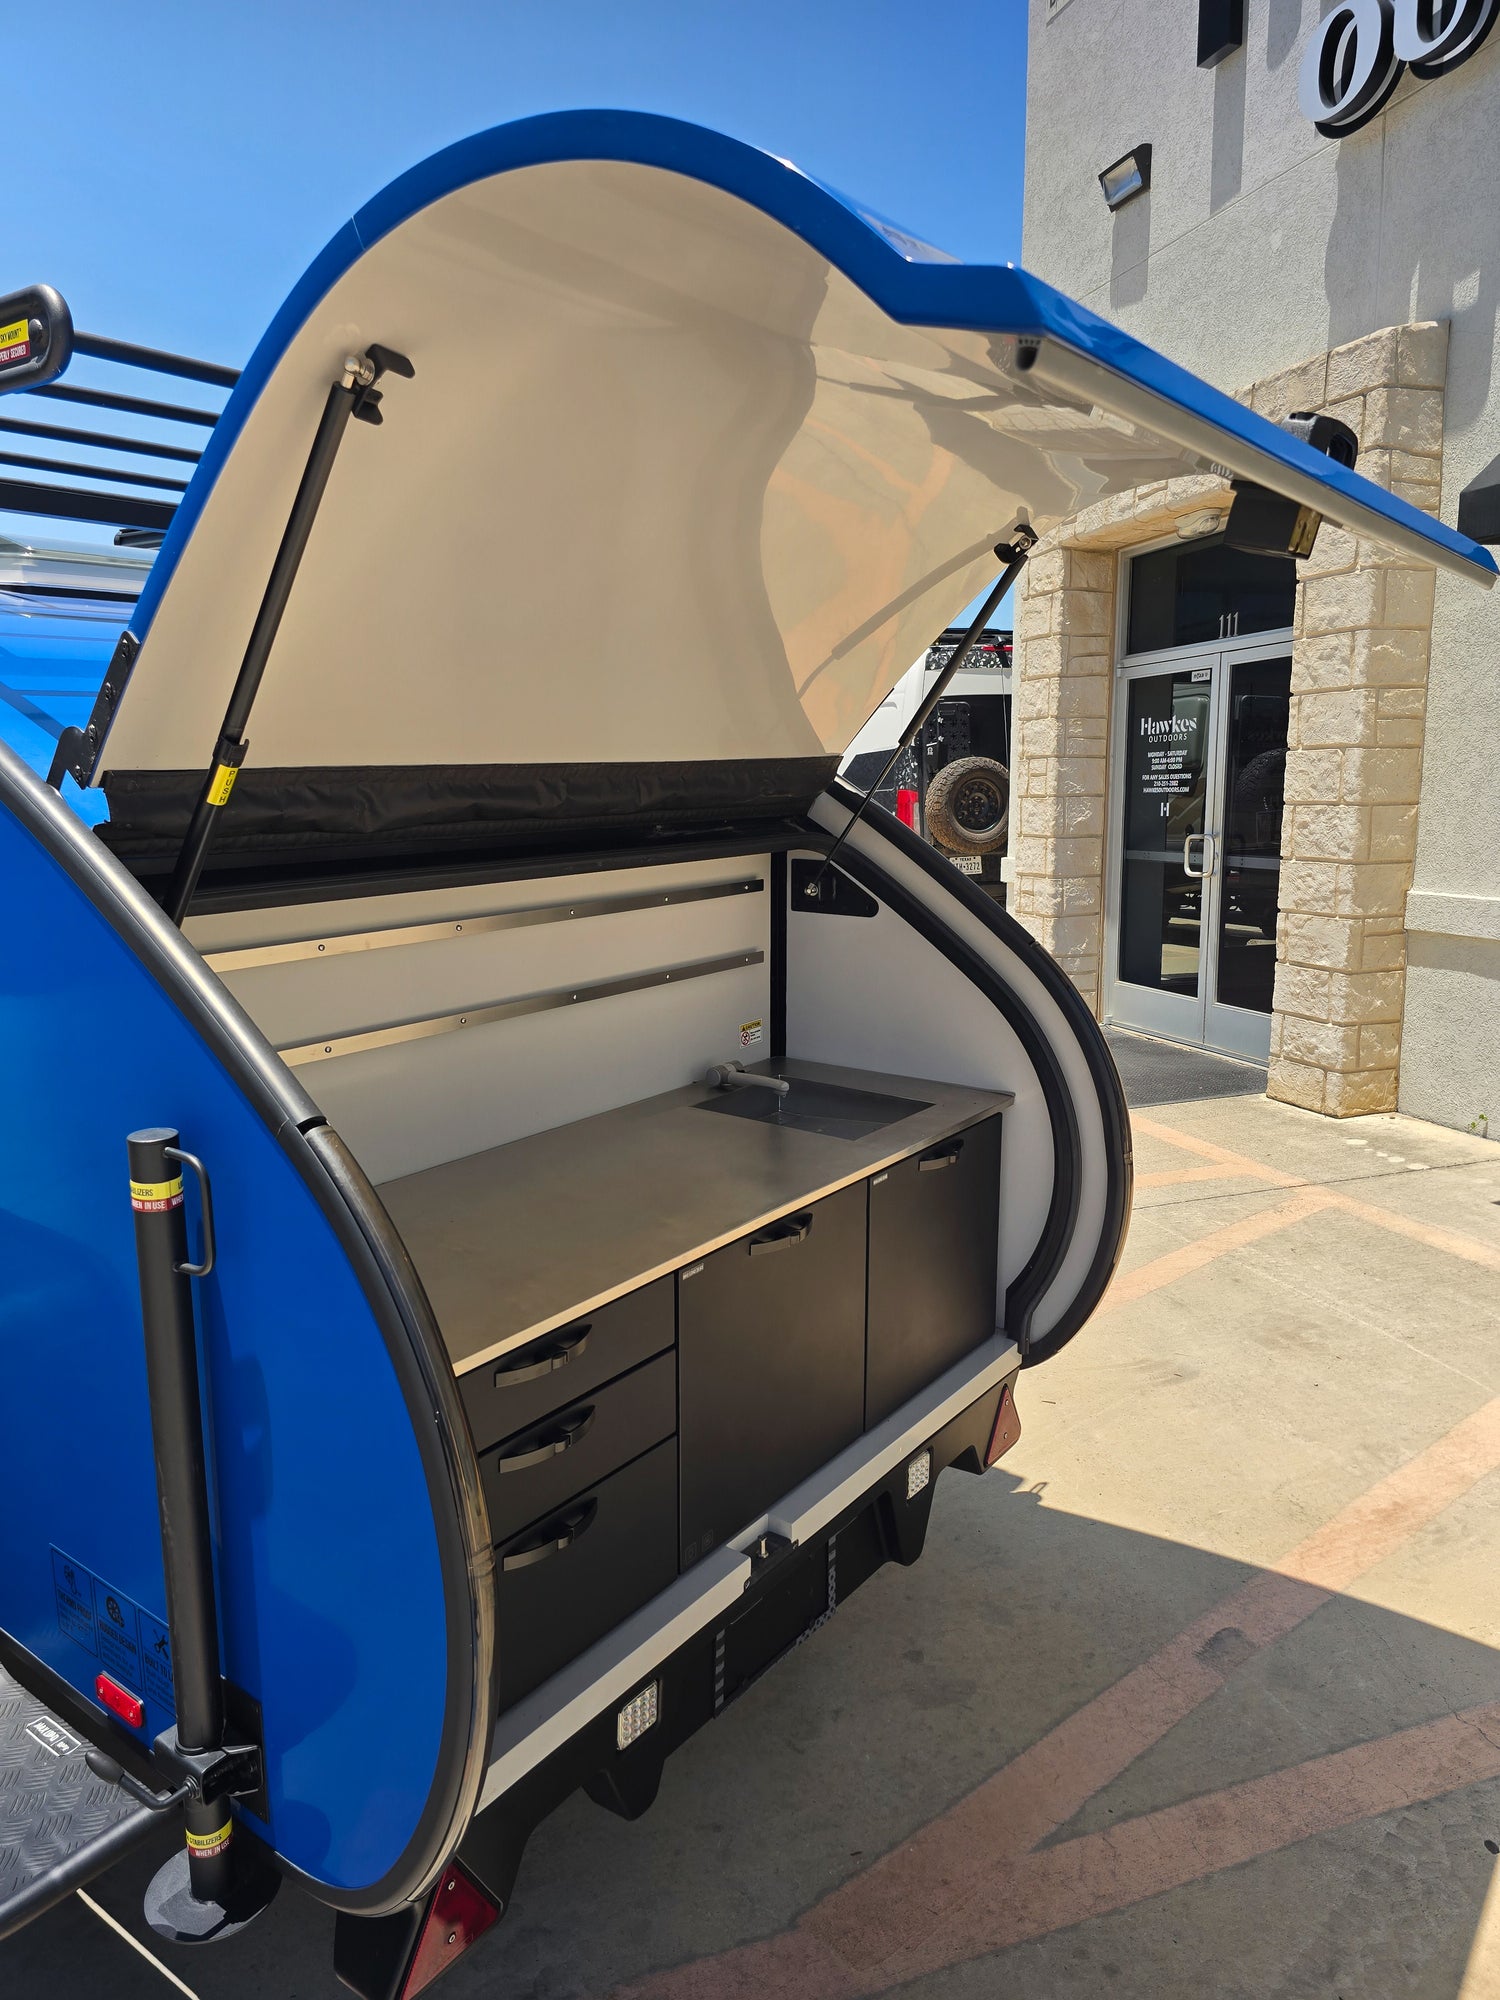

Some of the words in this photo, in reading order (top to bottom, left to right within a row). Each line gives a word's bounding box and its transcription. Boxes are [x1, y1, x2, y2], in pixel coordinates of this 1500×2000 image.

[1218, 612, 1239, 639] 111
[1141, 715, 1197, 735] Hawkes
[1148, 733, 1188, 743] OUTDOORS
[1169, 772, 1192, 780] QUESTIONS
[219, 770, 236, 803] PUSH
[152, 1200, 167, 1210] USE
[190, 1834, 222, 1846] STABILIZERS
[195, 1849, 212, 1857] WHEN
[214, 1846, 221, 1854] IN
[220, 1838, 230, 1850] USE
